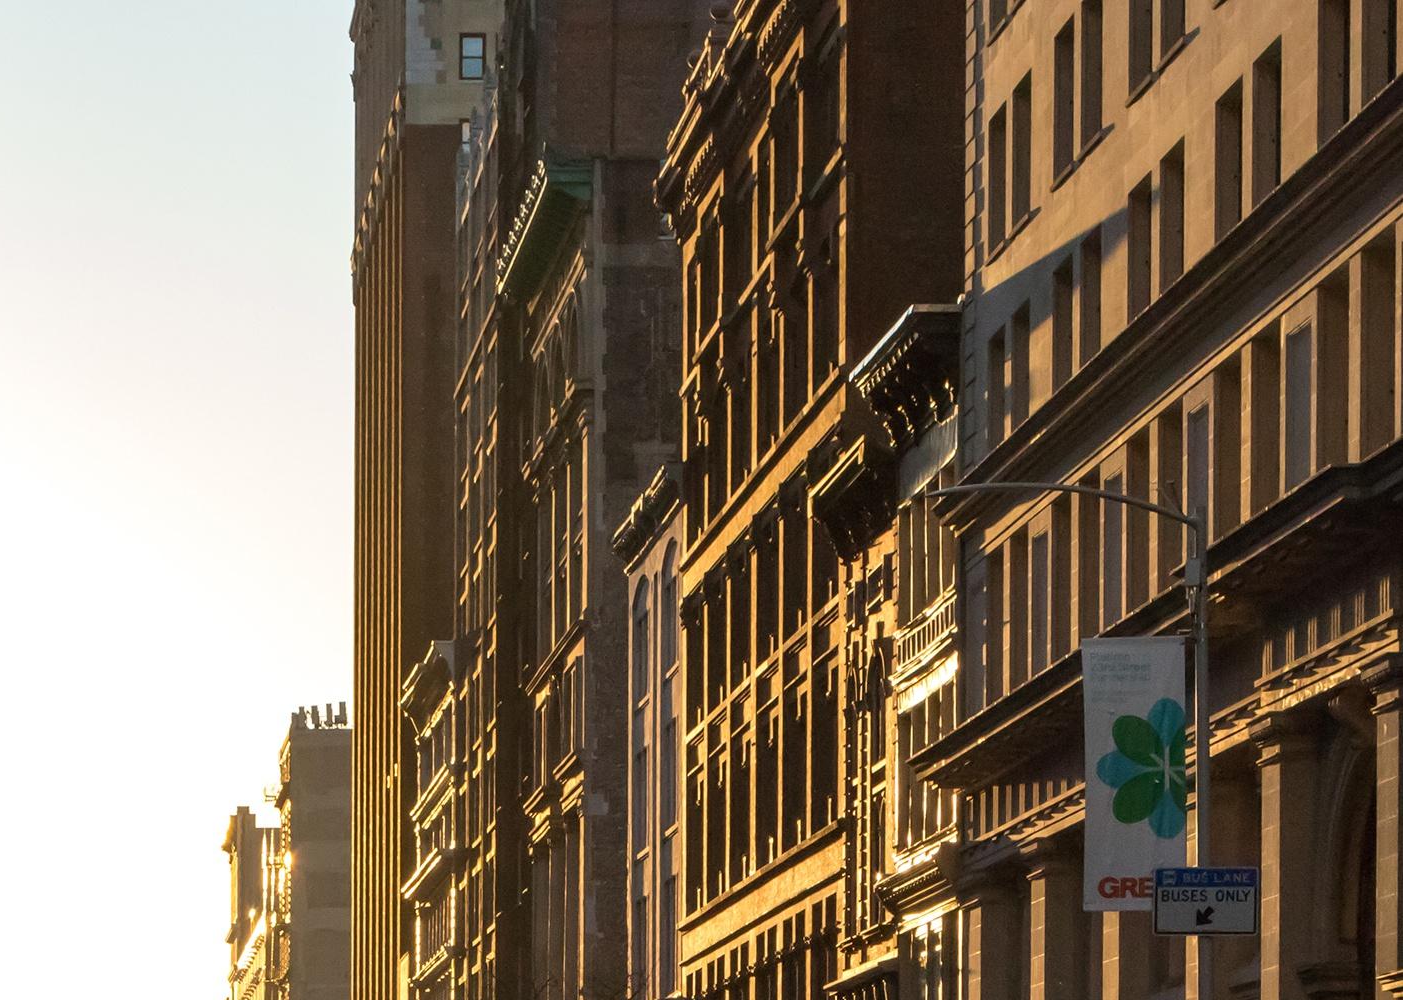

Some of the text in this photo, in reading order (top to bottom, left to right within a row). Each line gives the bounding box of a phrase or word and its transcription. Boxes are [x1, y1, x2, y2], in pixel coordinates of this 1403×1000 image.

[1182, 872, 1250, 883] BUS LANE
[1161, 889, 1251, 903] BUSES ONLY
